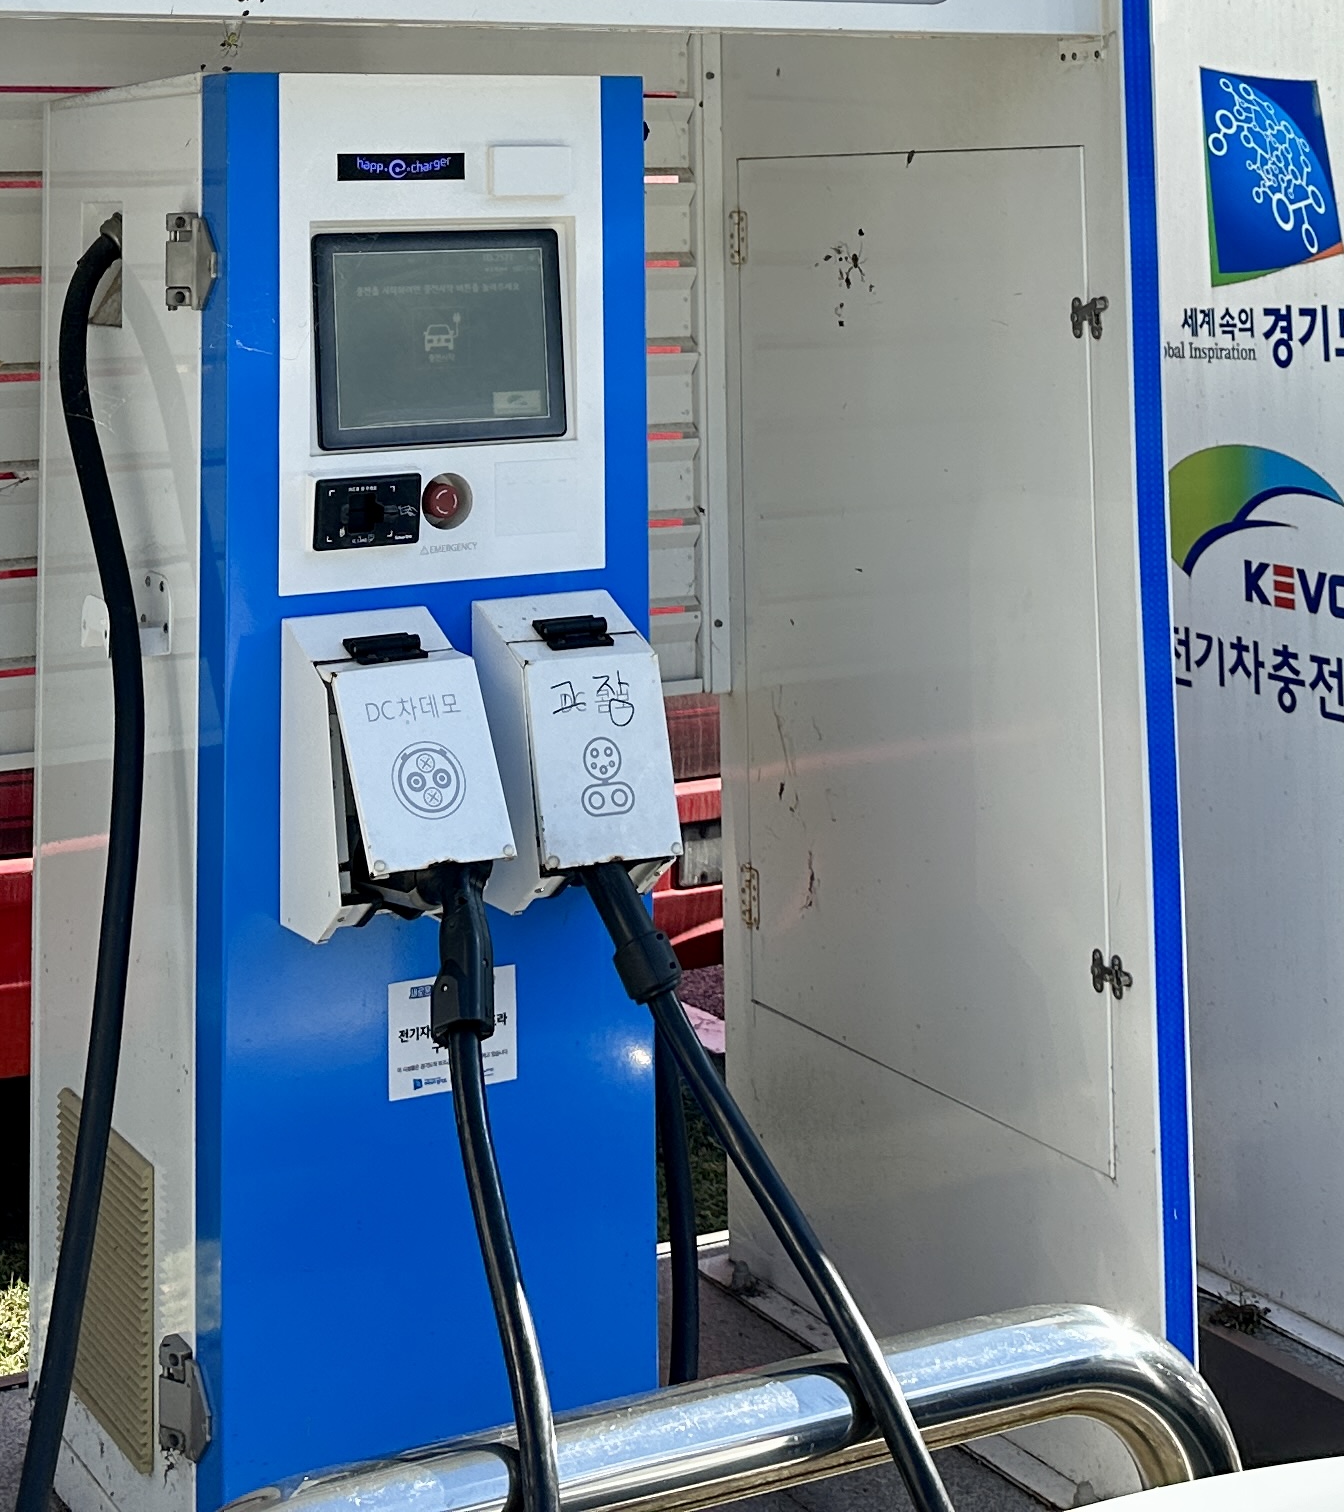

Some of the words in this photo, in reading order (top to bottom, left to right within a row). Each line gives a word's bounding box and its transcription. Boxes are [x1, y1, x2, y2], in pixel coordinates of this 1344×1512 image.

[1181, 307, 1216, 338] 세계
[1219, 306, 1255, 342] 속의
[1163, 341, 1186, 360] bal
[1189, 342, 1256, 364] Inspiration
